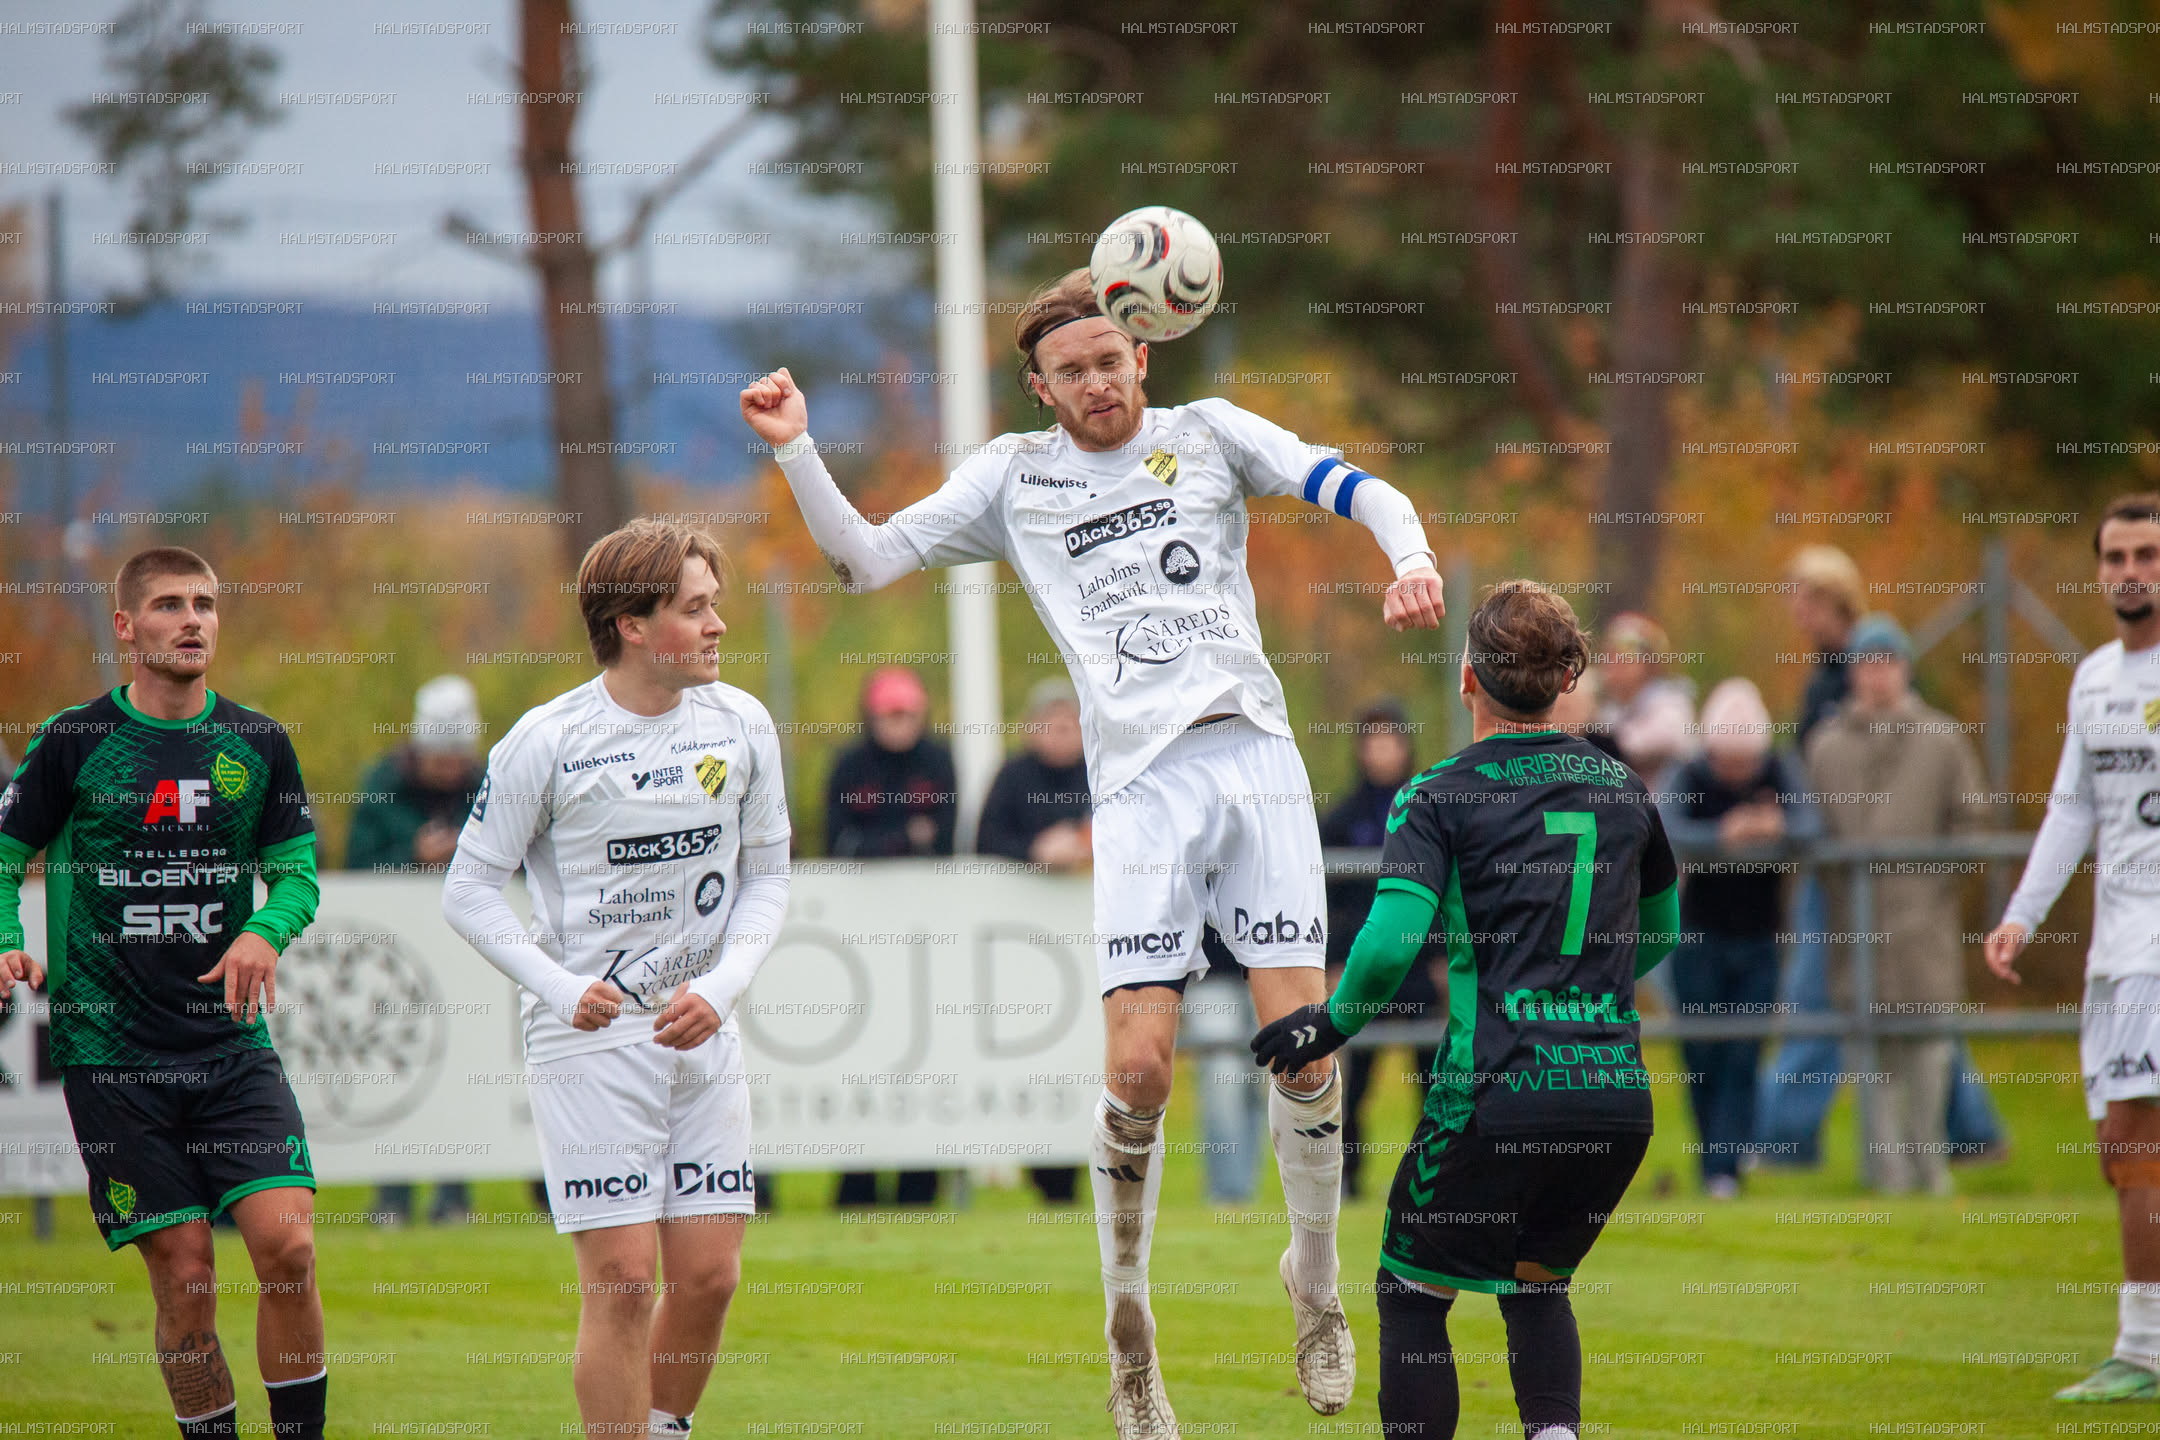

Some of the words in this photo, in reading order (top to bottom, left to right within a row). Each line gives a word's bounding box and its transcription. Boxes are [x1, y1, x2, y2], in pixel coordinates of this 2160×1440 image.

[1020, 473, 1087, 489] Liljekvists
[1078, 562, 1141, 600] Laholms
[1080, 581, 1149, 621] Sparbank
[1142, 604, 1230, 641] NÄREDS
[563, 752, 635, 773] Liljekvists
[652, 766, 683, 779] INTER
[653, 775, 684, 788] SPORT
[1507, 772, 1624, 788] TOTALENTREPRENAD
[143, 779, 210, 824] AF
[142, 824, 210, 832] SNICKERI
[123, 848, 227, 858] TRELLEBORG
[98, 866, 239, 887] BILCENTER
[1543, 811, 1598, 956] 7
[599, 888, 675, 904] Laholms
[122, 902, 224, 944] SRC
[588, 906, 674, 928] Sparbank
[1108, 930, 1183, 959] micor
[1535, 1043, 1638, 1066] NORDIC
